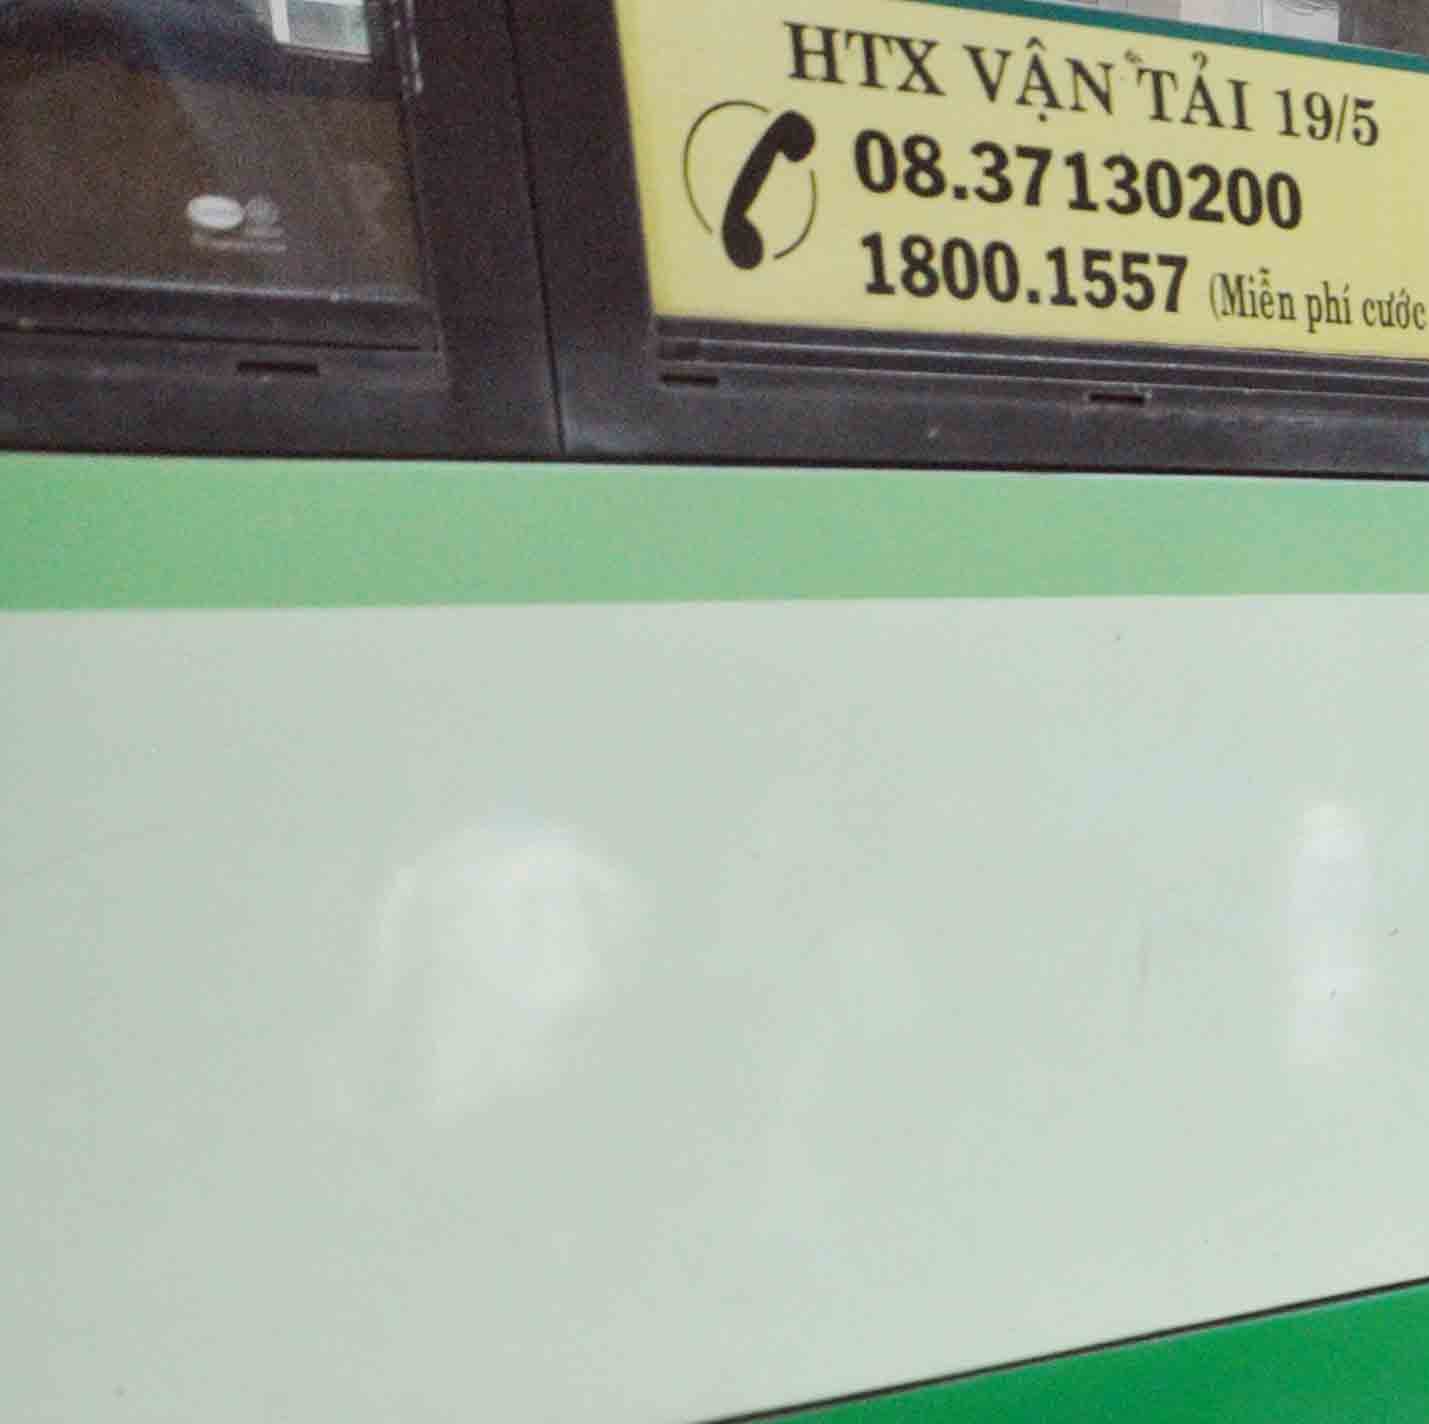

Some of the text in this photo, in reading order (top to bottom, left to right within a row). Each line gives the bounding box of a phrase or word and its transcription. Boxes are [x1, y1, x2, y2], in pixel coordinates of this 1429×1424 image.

[783, 22, 1379, 147] HTX VẬN TẢI 19/5
[854, 129, 1301, 230] 08.37130200
[861, 232, 1188, 313] 1800.1557
[1209, 266, 1296, 321] (Miễn
[1304, 280, 1352, 334] phí
[1362, 288, 1426, 330] cước
